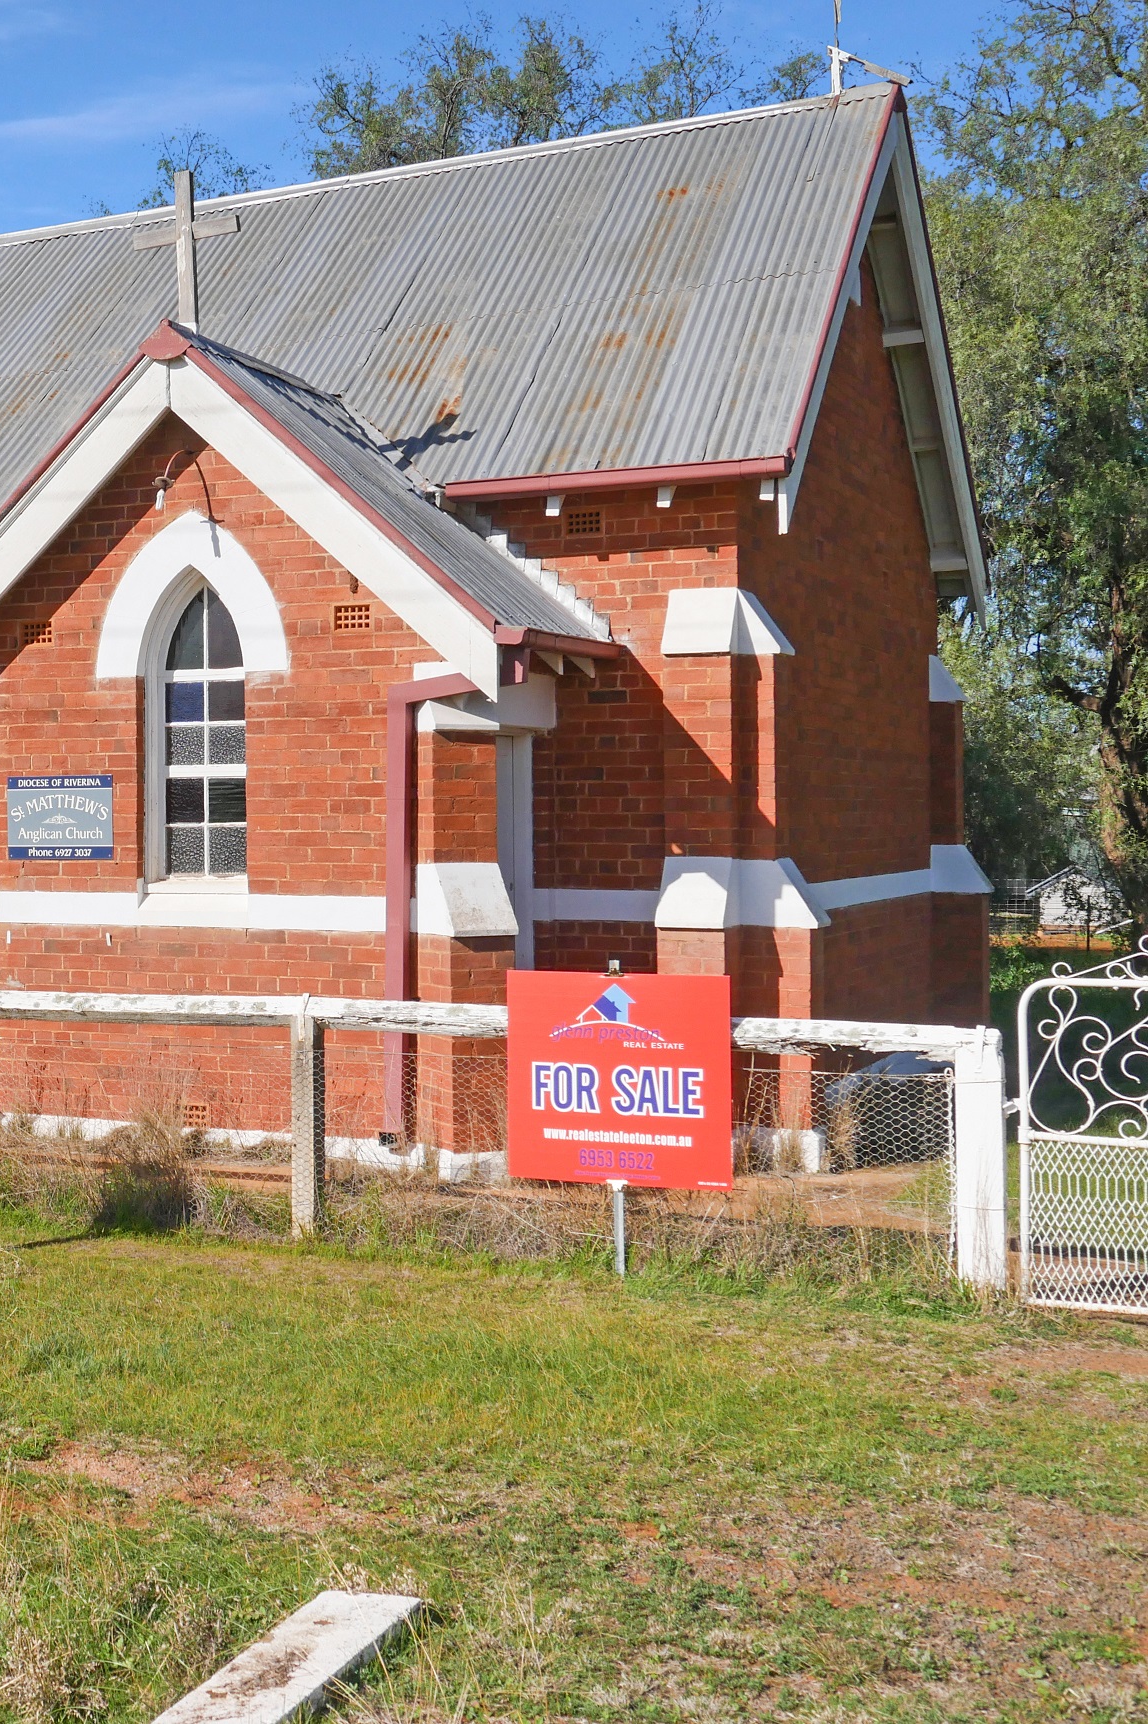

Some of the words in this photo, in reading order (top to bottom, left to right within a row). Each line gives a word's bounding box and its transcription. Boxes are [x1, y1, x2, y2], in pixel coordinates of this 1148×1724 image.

[18, 779, 49, 787] DIOCESE
[51, 779, 62, 787] OF
[64, 778, 101, 786] RIVERINA
[10, 805, 26, 822] St
[25, 794, 109, 821] MATTHEW'S
[18, 828, 62, 843] Anglican
[65, 827, 103, 839] Church
[28, 847, 53, 857] Phone
[54, 848, 72, 857] 6927
[74, 848, 92, 857] 3037
[551, 1022, 593, 1042] glenn
[598, 1026, 661, 1043] preston
[623, 1041, 648, 1049] REAL
[650, 1042, 685, 1050] ESTATE
[531, 1061, 601, 1114] FOR
[611, 1064, 704, 1119] SALE
[543, 1127, 693, 1147] www.realestateleeton.com.au
[579, 1148, 614, 1168] 6953
[618, 1151, 655, 1170] 6522
